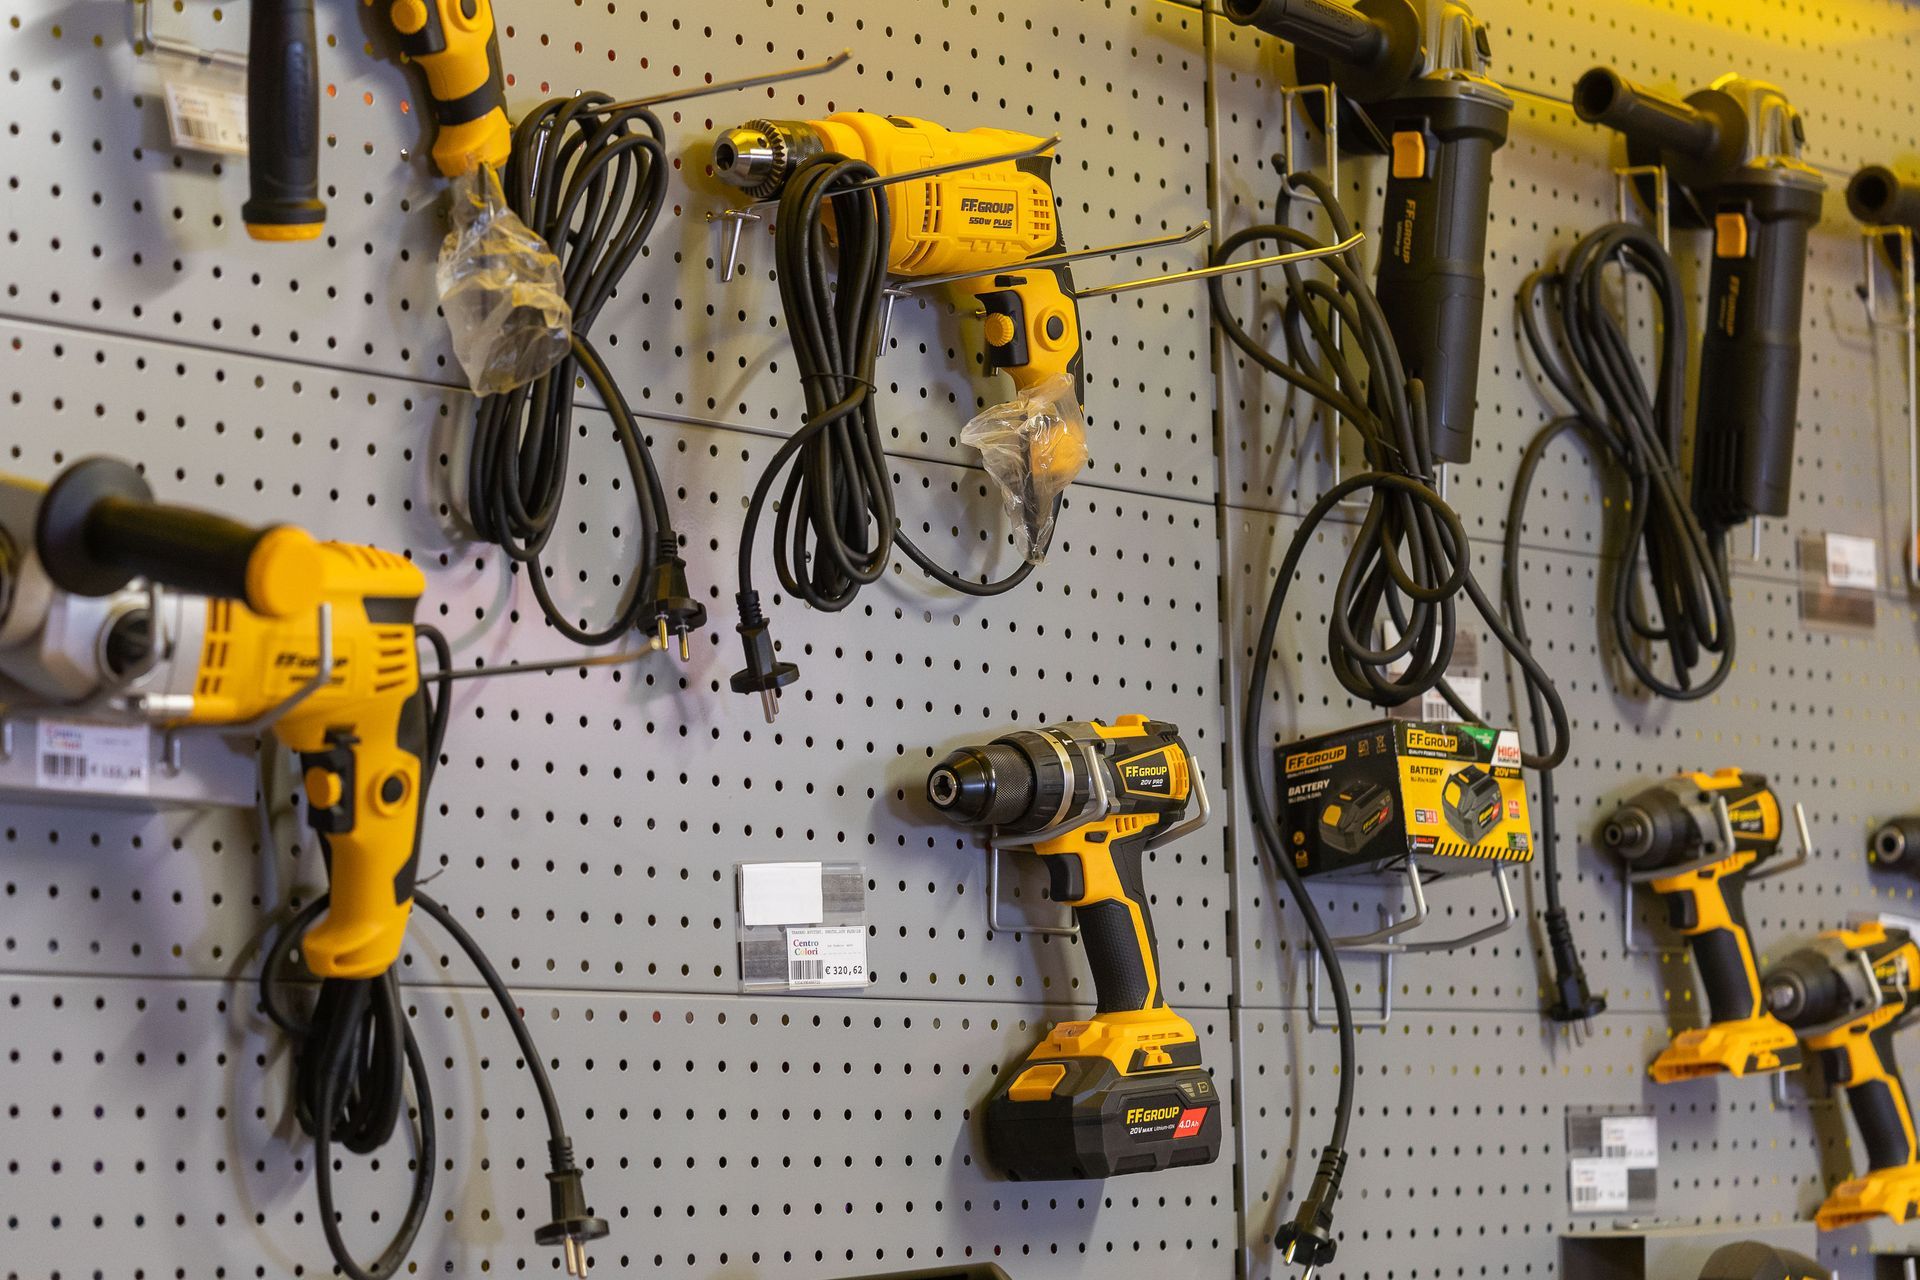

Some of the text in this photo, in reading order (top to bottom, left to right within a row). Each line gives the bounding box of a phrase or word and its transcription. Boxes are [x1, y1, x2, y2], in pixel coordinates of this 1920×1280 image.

[993, 218, 1012, 227] PLUS
[1498, 745, 1519, 758] HIGH
[1410, 765, 1443, 776] BATTERY
[1288, 778, 1330, 797] BATTERY
[793, 939, 819, 947] Centro
[794, 947, 818, 956] Colori
[833, 965, 863, 976] 320,62
